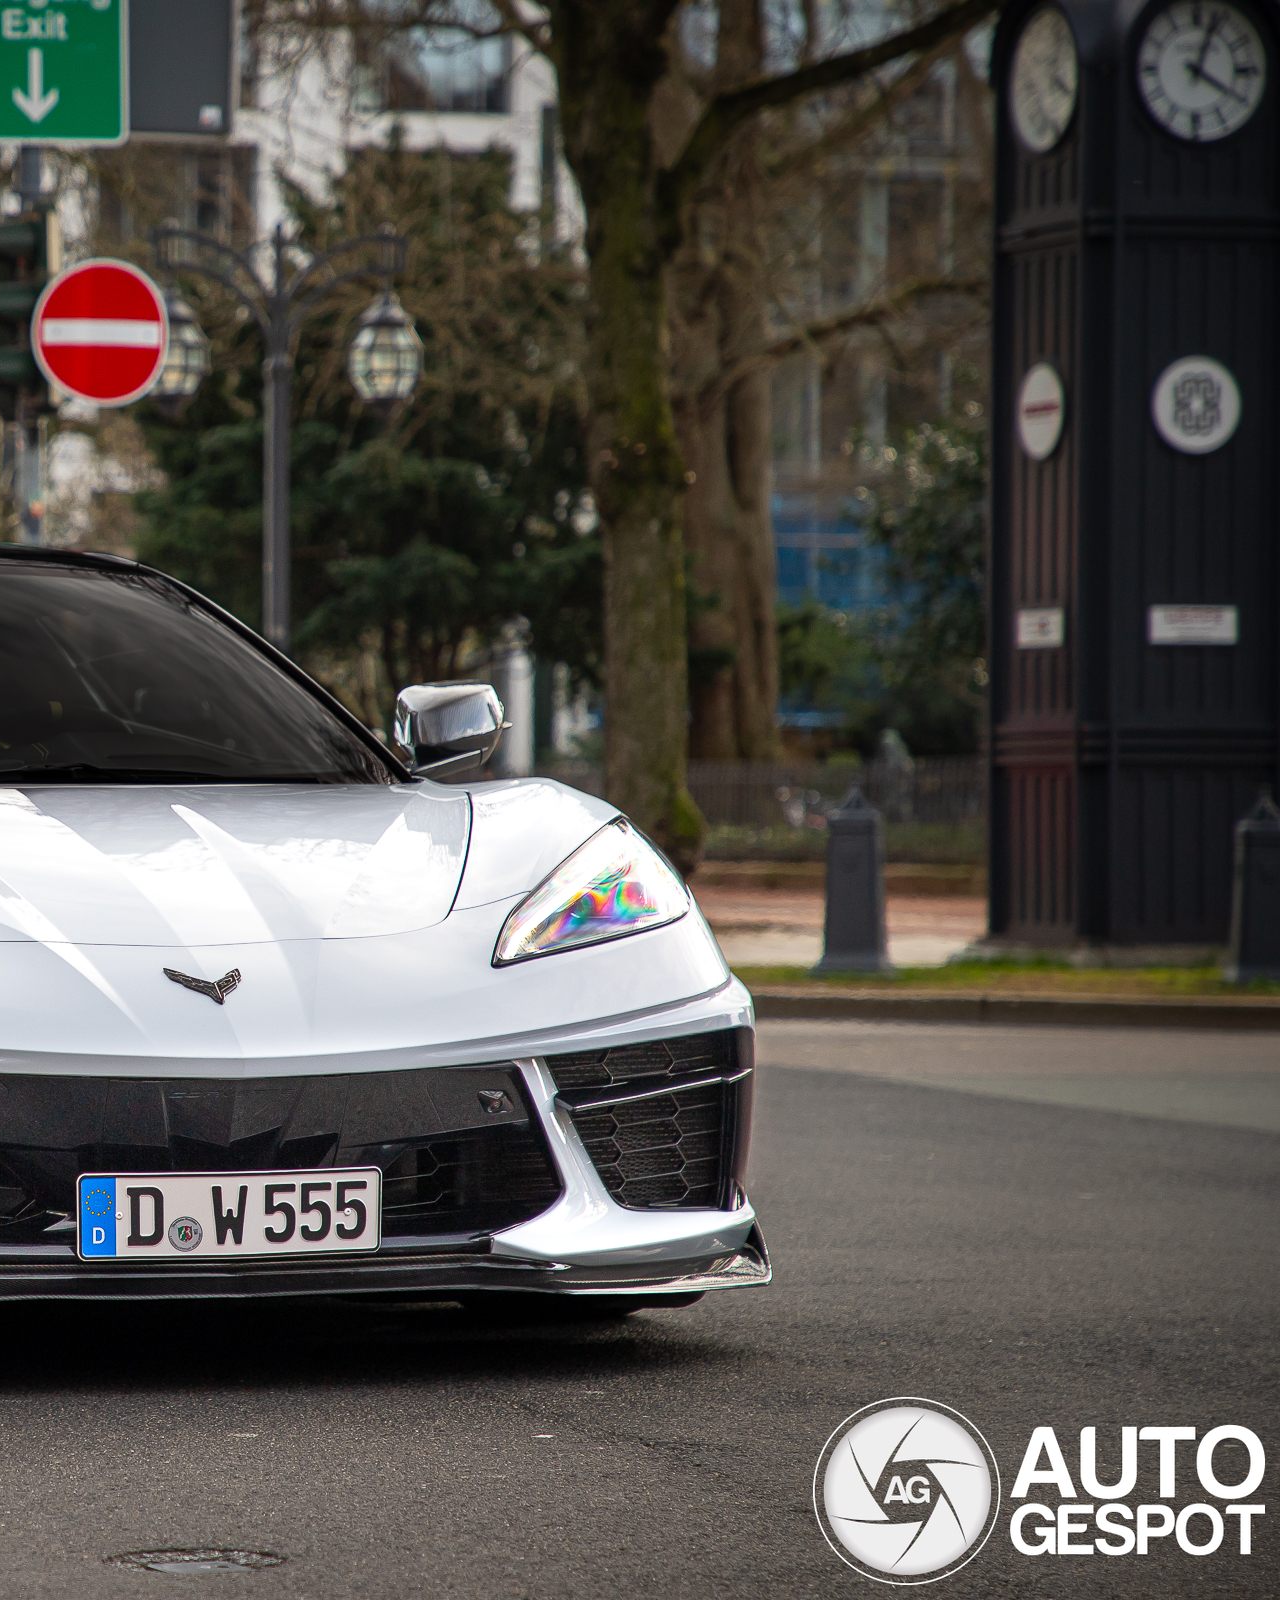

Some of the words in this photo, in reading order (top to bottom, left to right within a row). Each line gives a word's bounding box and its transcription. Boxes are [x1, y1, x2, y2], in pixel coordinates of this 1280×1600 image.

[1, 8, 67, 41] Exit
[126, 1185, 164, 1247] D
[211, 1184, 249, 1246] W
[264, 1180, 368, 1244] 555
[92, 1227, 106, 1245] D
